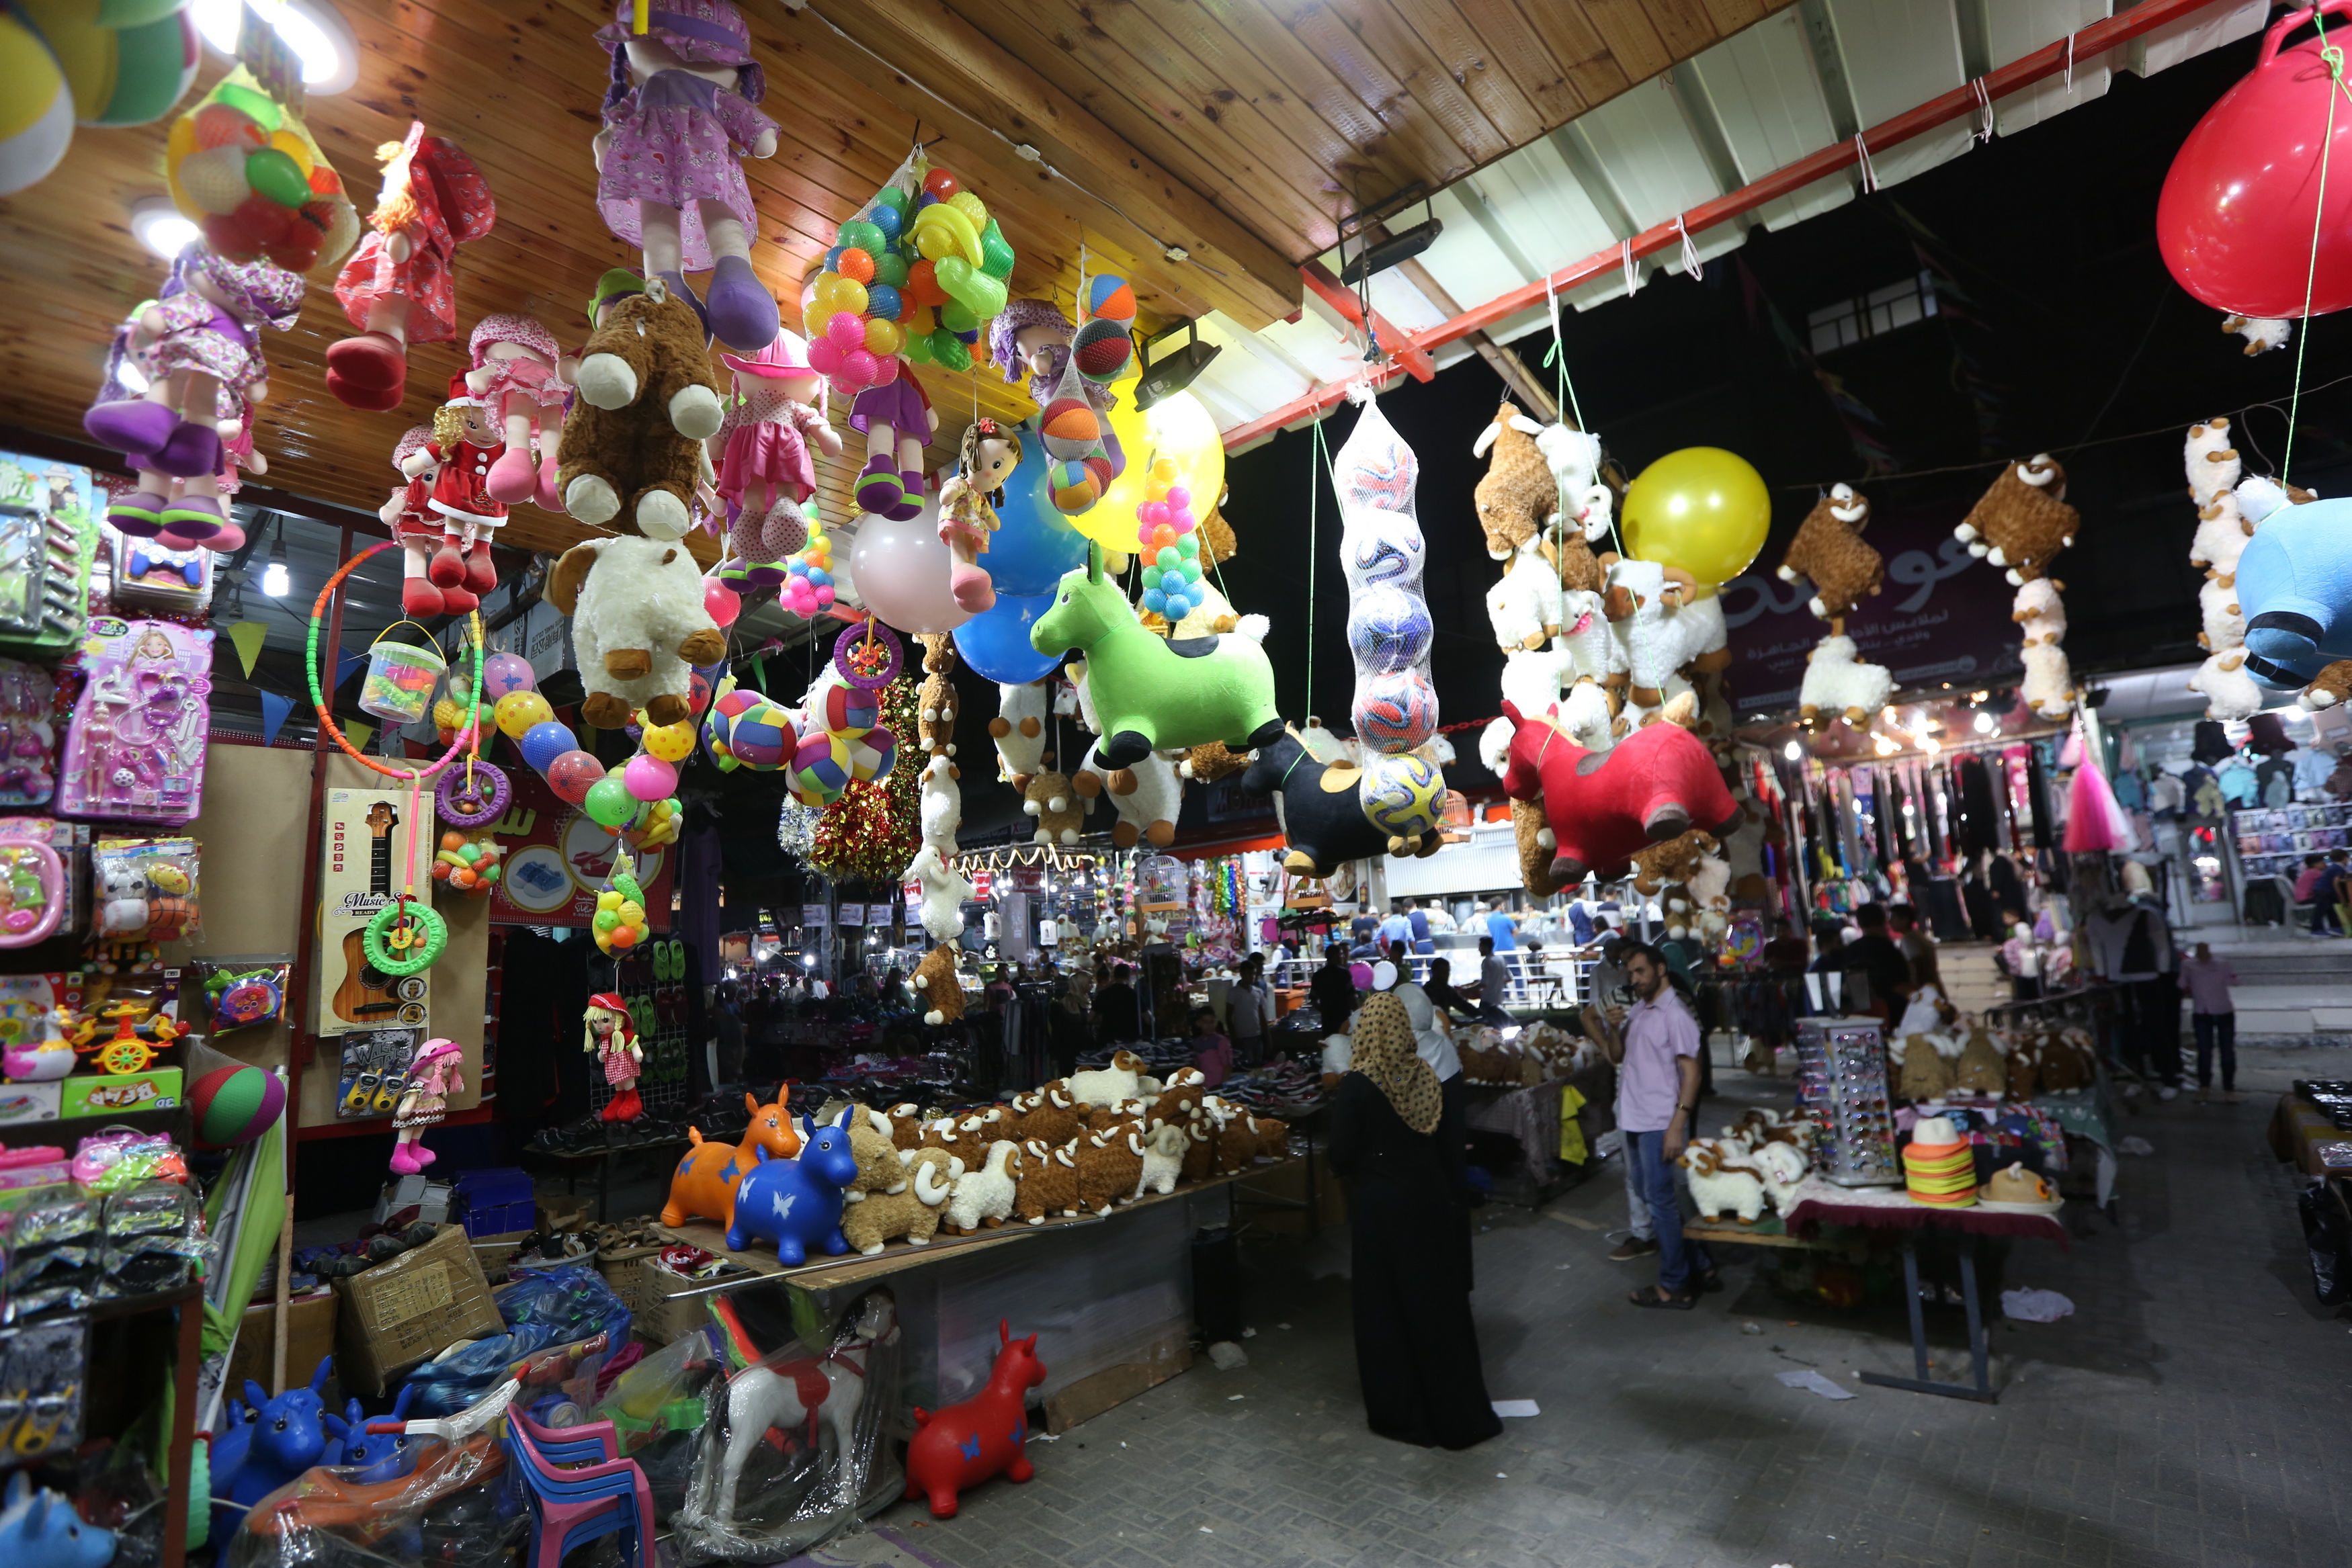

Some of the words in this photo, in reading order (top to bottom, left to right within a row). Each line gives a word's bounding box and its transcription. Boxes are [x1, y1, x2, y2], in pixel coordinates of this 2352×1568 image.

[544, 624, 554, 634] PANEL
[343, 892, 386, 908] Music
[351, 1041, 395, 1065] Walkie
[371, 1049, 409, 1068] Talkie
[89, 1082, 157, 1106] BEAR
[155, 1097, 175, 1108] 3D
[375, 1285, 386, 1293] ART
[376, 1293, 388, 1301] SIZE
[378, 1297, 399, 1309] YELLOW
[445, 1302, 459, 1311] KGS
[379, 1307, 396, 1318] BLACK
[448, 1309, 462, 1318] KGS
[380, 1314, 401, 1326] BROWN
[394, 1321, 410, 1332] QTY
